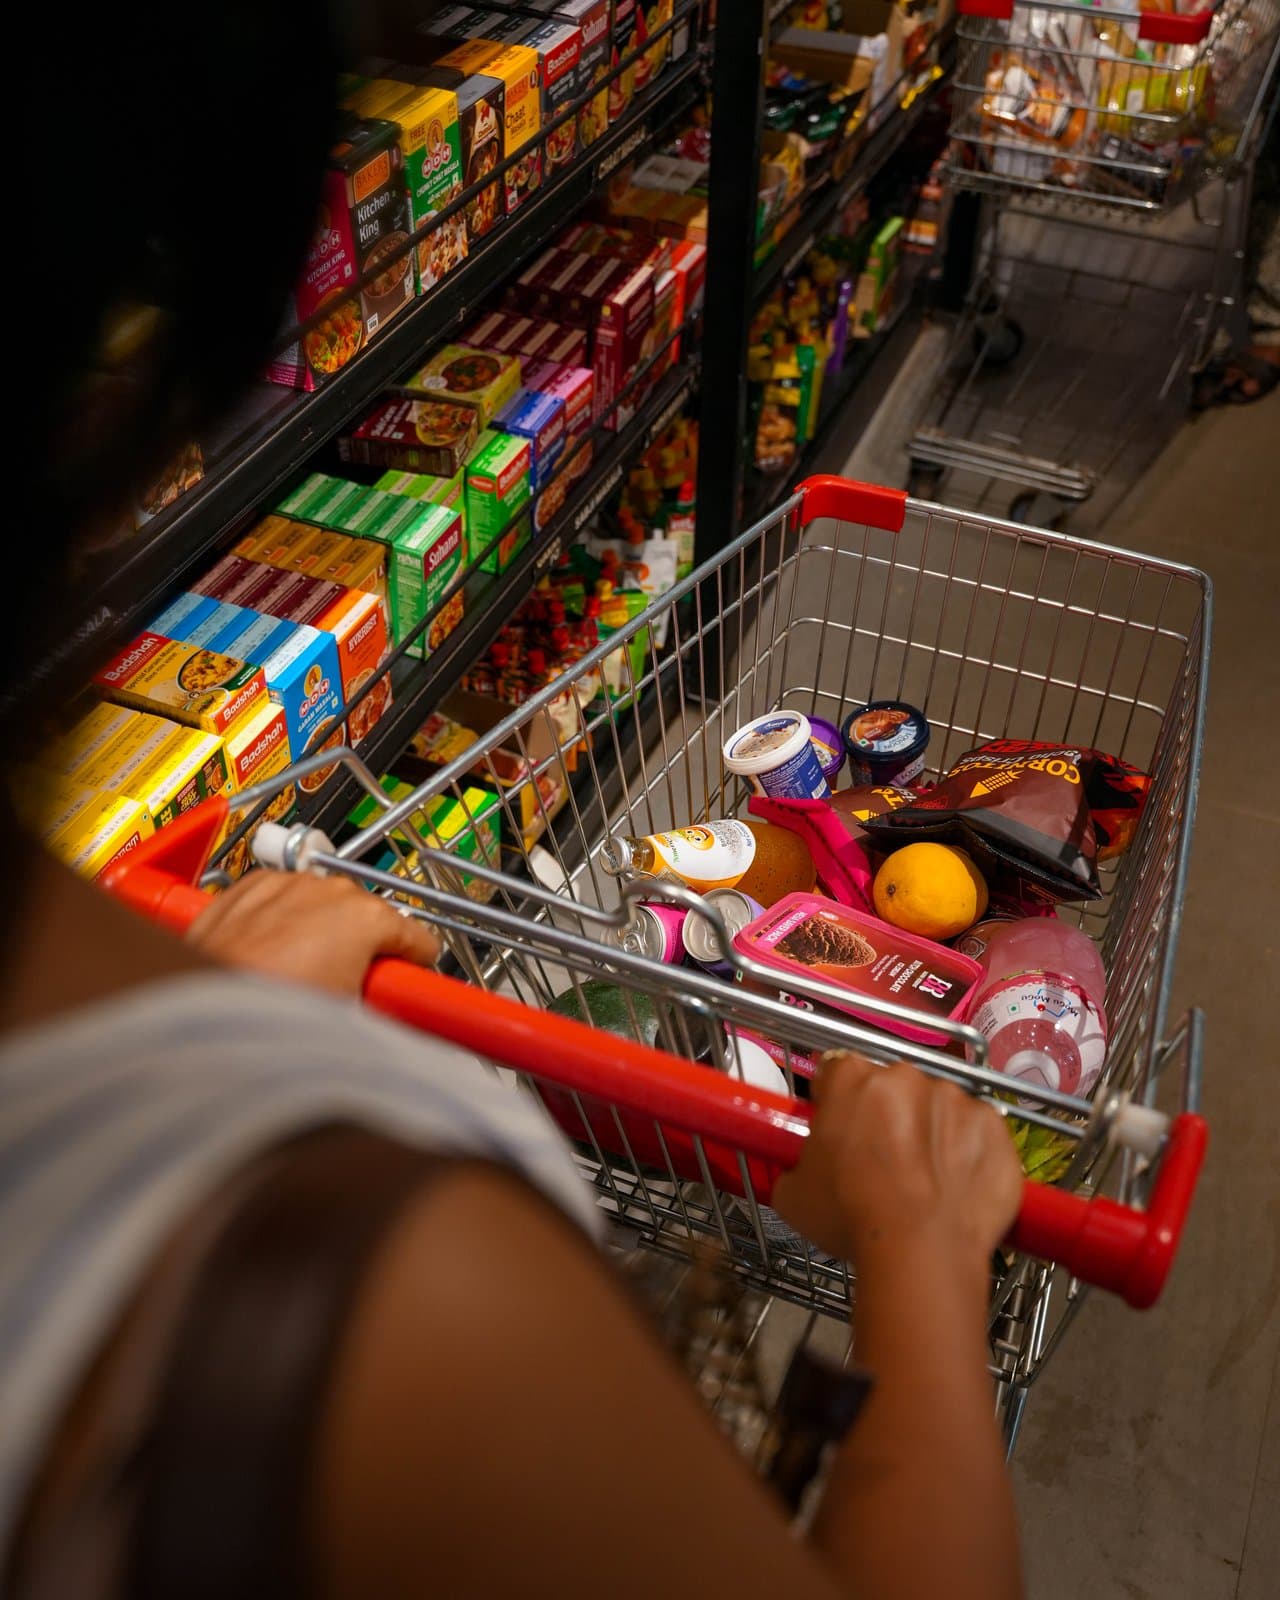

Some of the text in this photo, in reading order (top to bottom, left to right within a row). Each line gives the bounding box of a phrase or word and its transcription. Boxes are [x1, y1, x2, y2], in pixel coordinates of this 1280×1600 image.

[547, 43, 578, 74] Badshah
[423, 145, 450, 177] MDH
[357, 191, 390, 224] Kitchen
[359, 219, 379, 243] King
[330, 249, 346, 268] KING
[429, 530, 459, 572] Suhana
[348, 613, 378, 652] EVEREST
[104, 637, 159, 682] Badshah
[223, 681, 259, 721] Badshah
[300, 679, 329, 717] MDH
[315, 690, 335, 713] MASALA
[240, 722, 283, 771] Badshah
[961, 754, 1028, 766] Crisps
[947, 758, 1081, 784] CORNITOS
[889, 967, 915, 993] CHOCOLATE
[919, 973, 953, 999] BR
[770, 1047, 797, 1066] MEA
